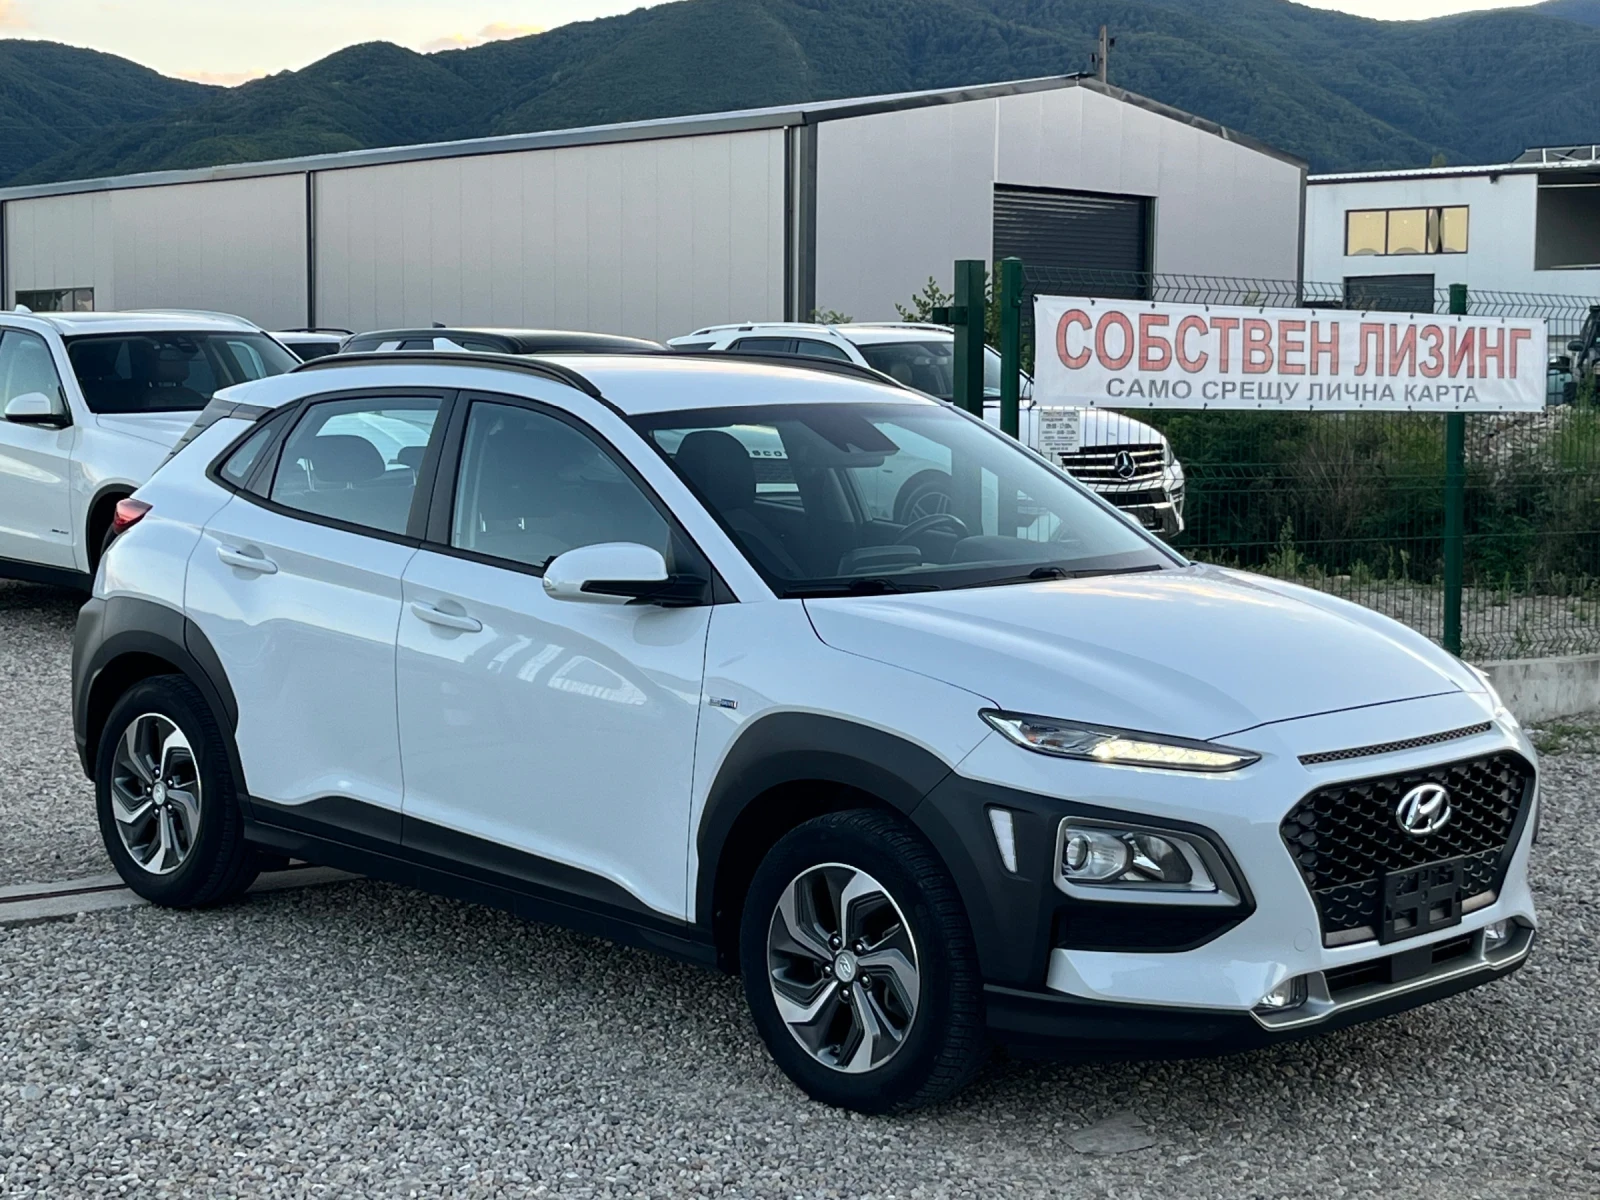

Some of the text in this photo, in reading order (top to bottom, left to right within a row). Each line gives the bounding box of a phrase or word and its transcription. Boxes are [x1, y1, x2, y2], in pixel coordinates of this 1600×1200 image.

[1056, 308, 1531, 379] СОБСТВЕН ЛИЗИНГ
[1106, 377, 1479, 403] САМО СРЕЩУ ЛИЧНА КАРТА
